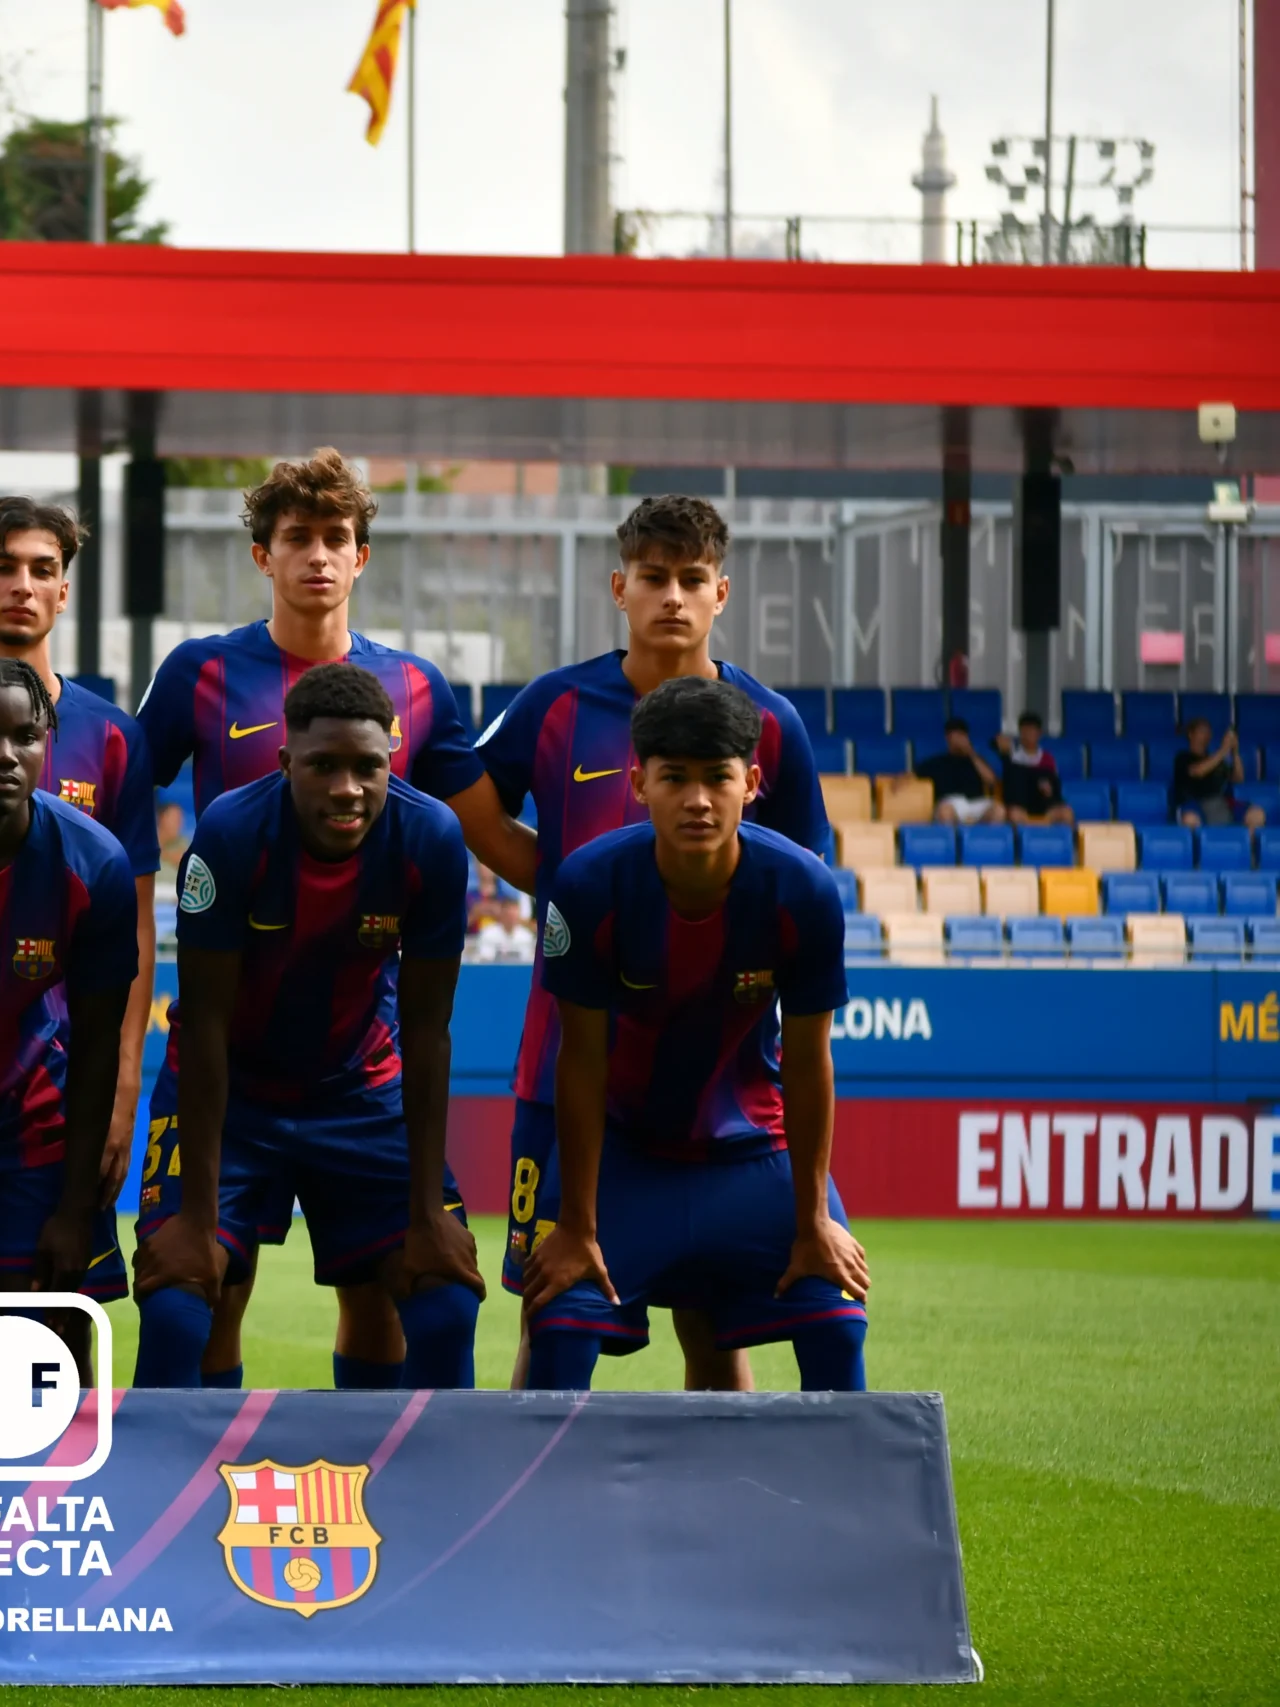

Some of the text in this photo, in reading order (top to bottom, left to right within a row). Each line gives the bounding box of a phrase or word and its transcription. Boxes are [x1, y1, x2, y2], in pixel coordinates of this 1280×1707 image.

[512, 1157, 540, 1223] 8
[957, 1111, 1280, 1211] ENTRADE
[268, 1526, 329, 1545] FCB
